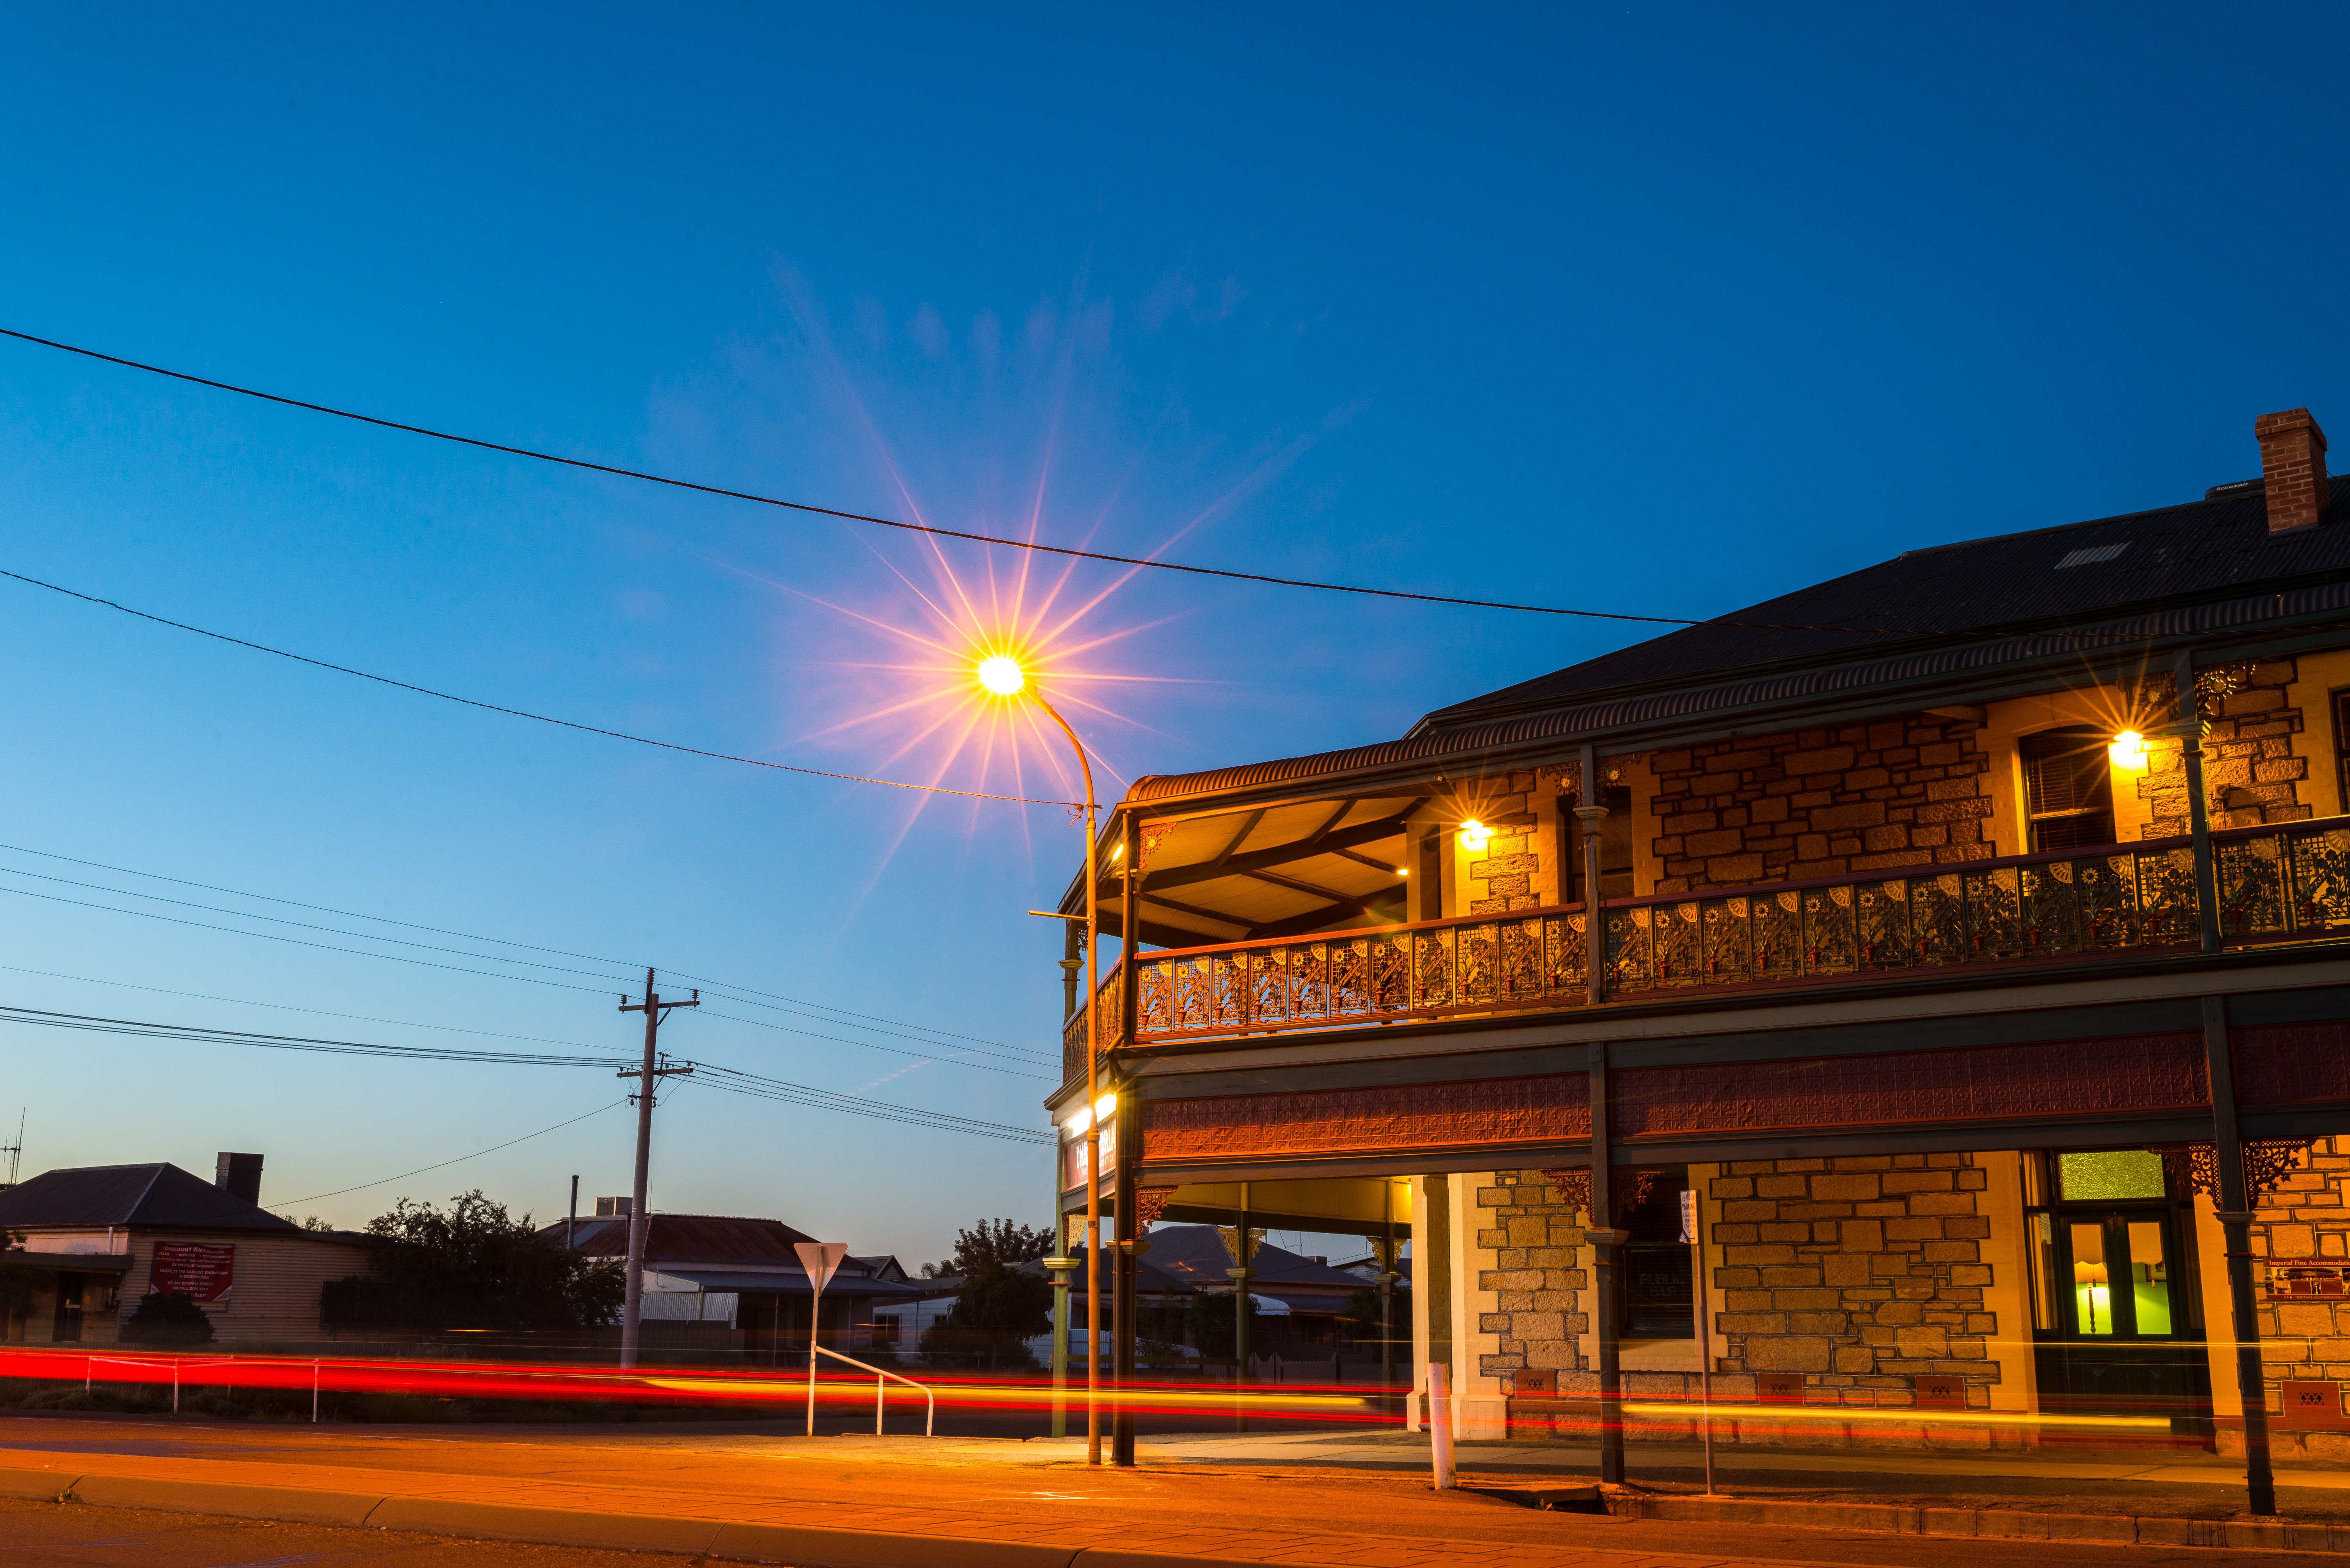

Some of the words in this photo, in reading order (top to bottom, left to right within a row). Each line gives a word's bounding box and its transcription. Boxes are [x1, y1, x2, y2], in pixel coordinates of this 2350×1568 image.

[1076, 1140, 1088, 1169] THE
[1640, 1274, 1685, 1284] PUBLIC
[1650, 1286, 1676, 1297] BAR
